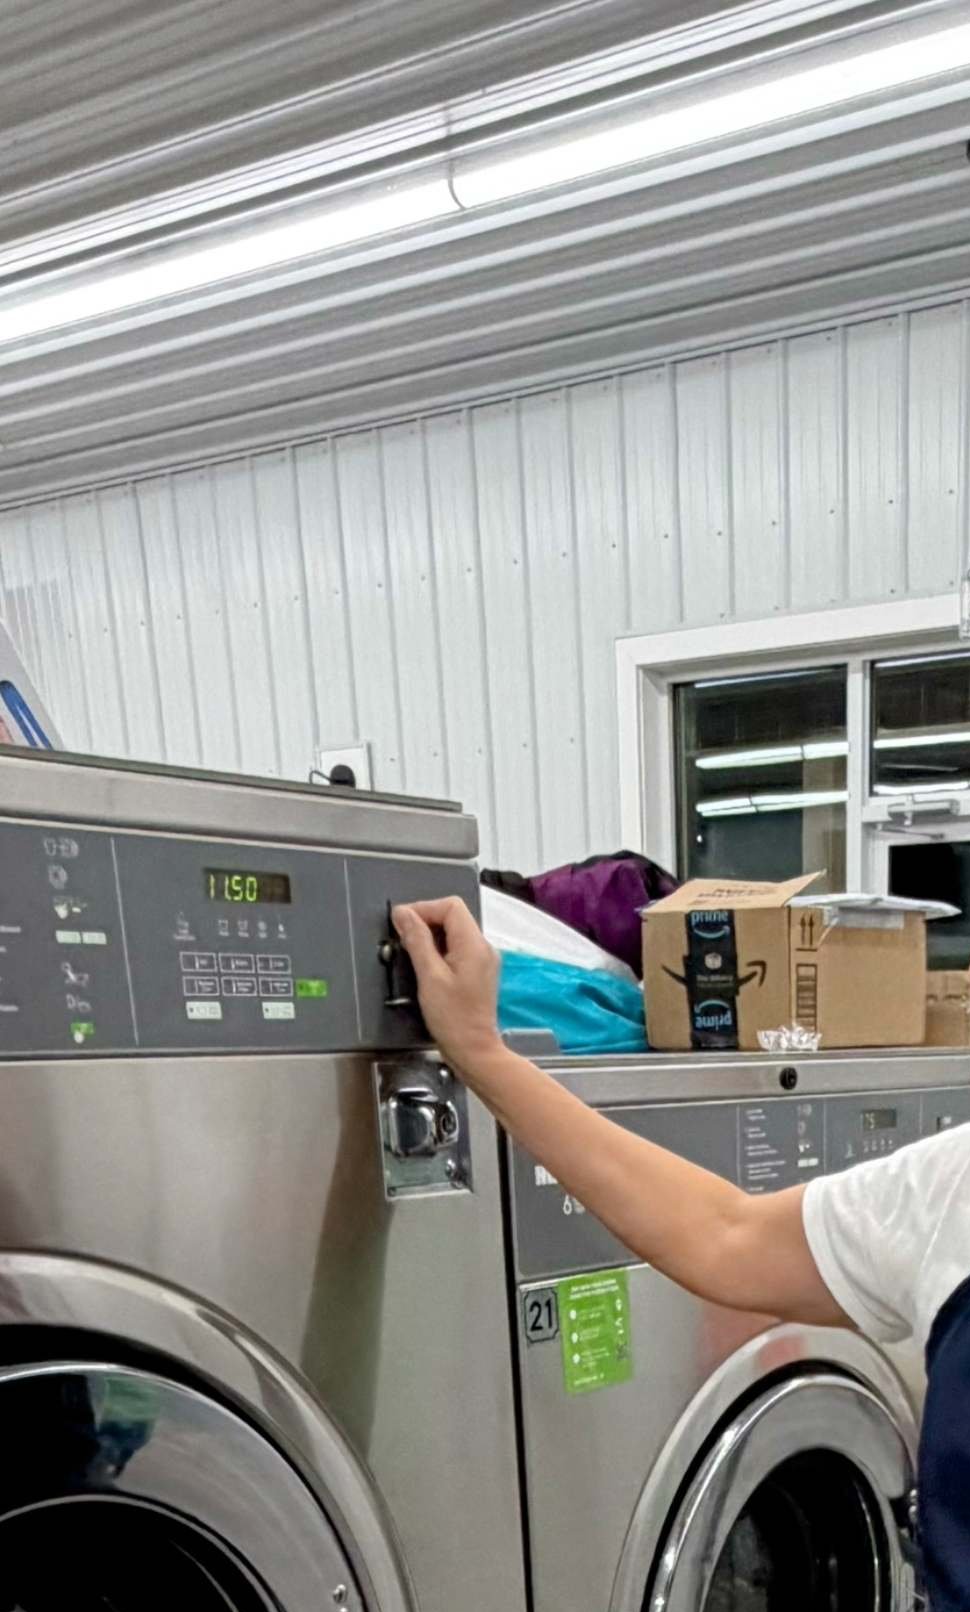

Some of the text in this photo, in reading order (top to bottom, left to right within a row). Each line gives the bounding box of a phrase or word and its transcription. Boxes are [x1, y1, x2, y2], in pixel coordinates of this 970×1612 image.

[690, 910, 729, 924] prime
[695, 1008, 732, 1031] prime
[529, 1297, 553, 1332] 21
